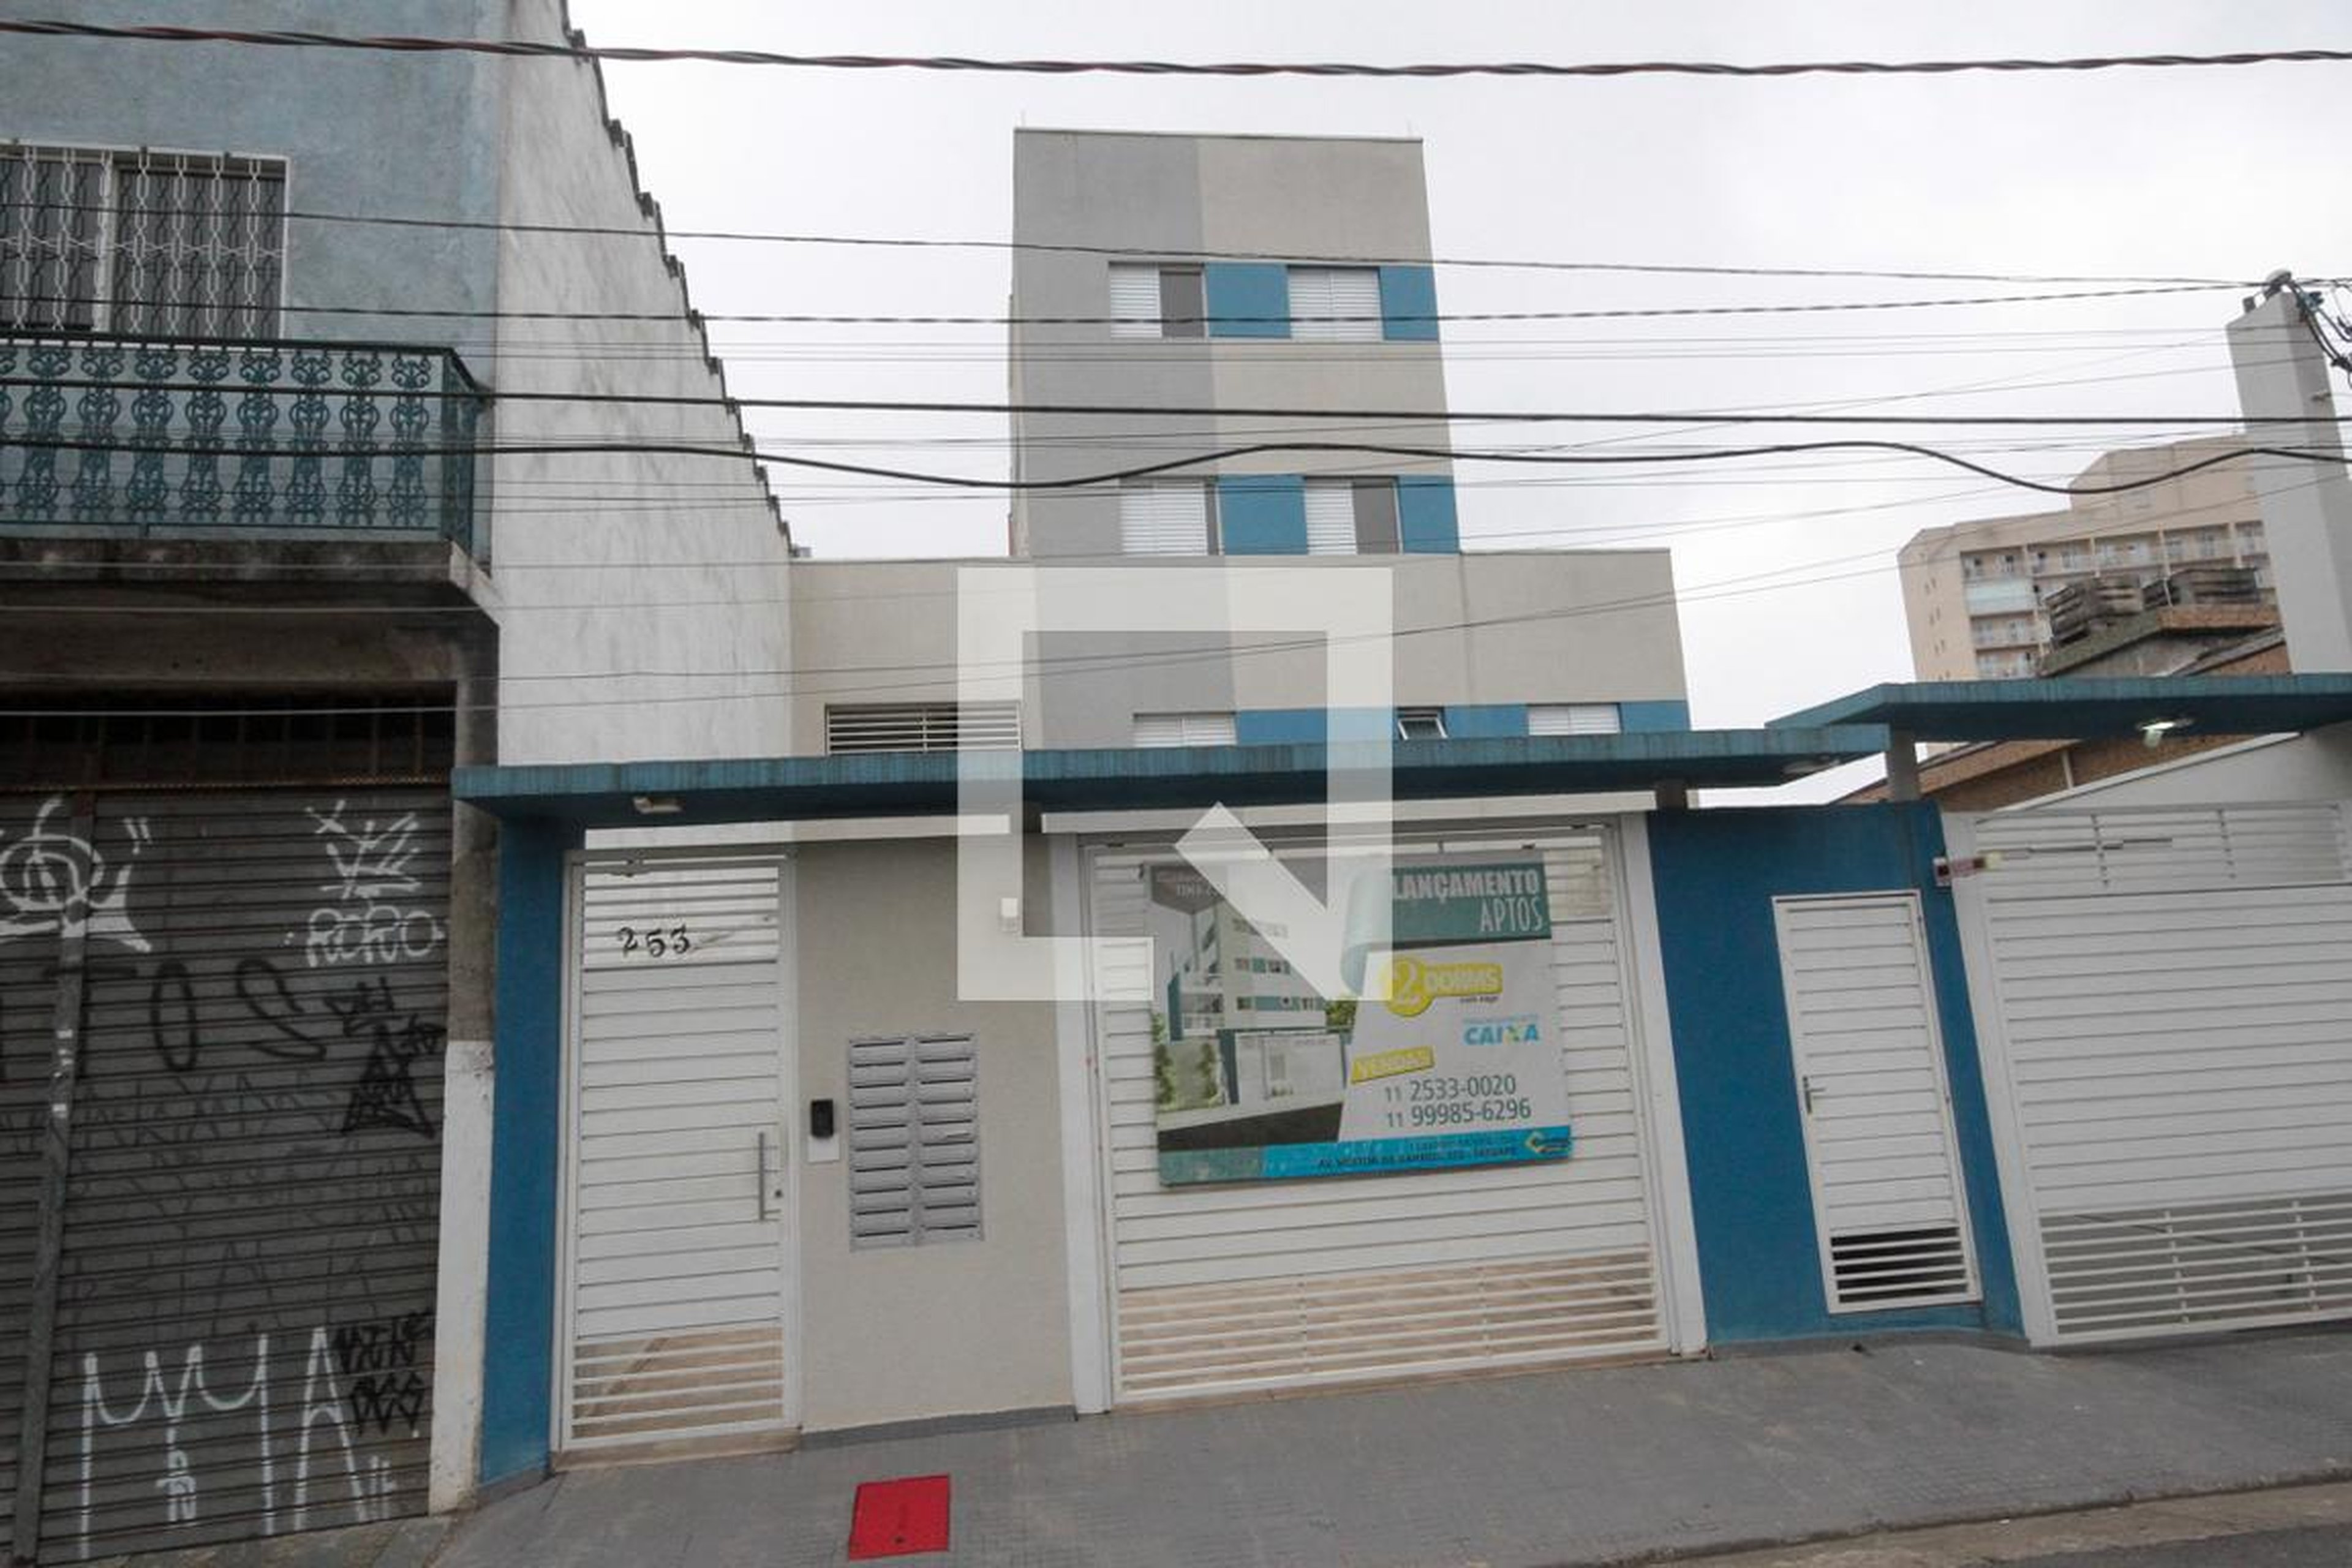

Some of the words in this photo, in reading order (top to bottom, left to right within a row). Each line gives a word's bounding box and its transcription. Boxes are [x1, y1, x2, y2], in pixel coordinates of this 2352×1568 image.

[1395, 869, 1539, 903] LANÇAMENTO
[1479, 896, 1543, 933] APTOS
[617, 924, 690, 957] 253
[1464, 1023, 1539, 1046] CAIXA
[1385, 1086, 1402, 1102] 11
[1411, 1075, 1516, 1101] 2533-0020
[1388, 1111, 1403, 1127] 11
[1411, 1098, 1531, 1126] 99985-6296
